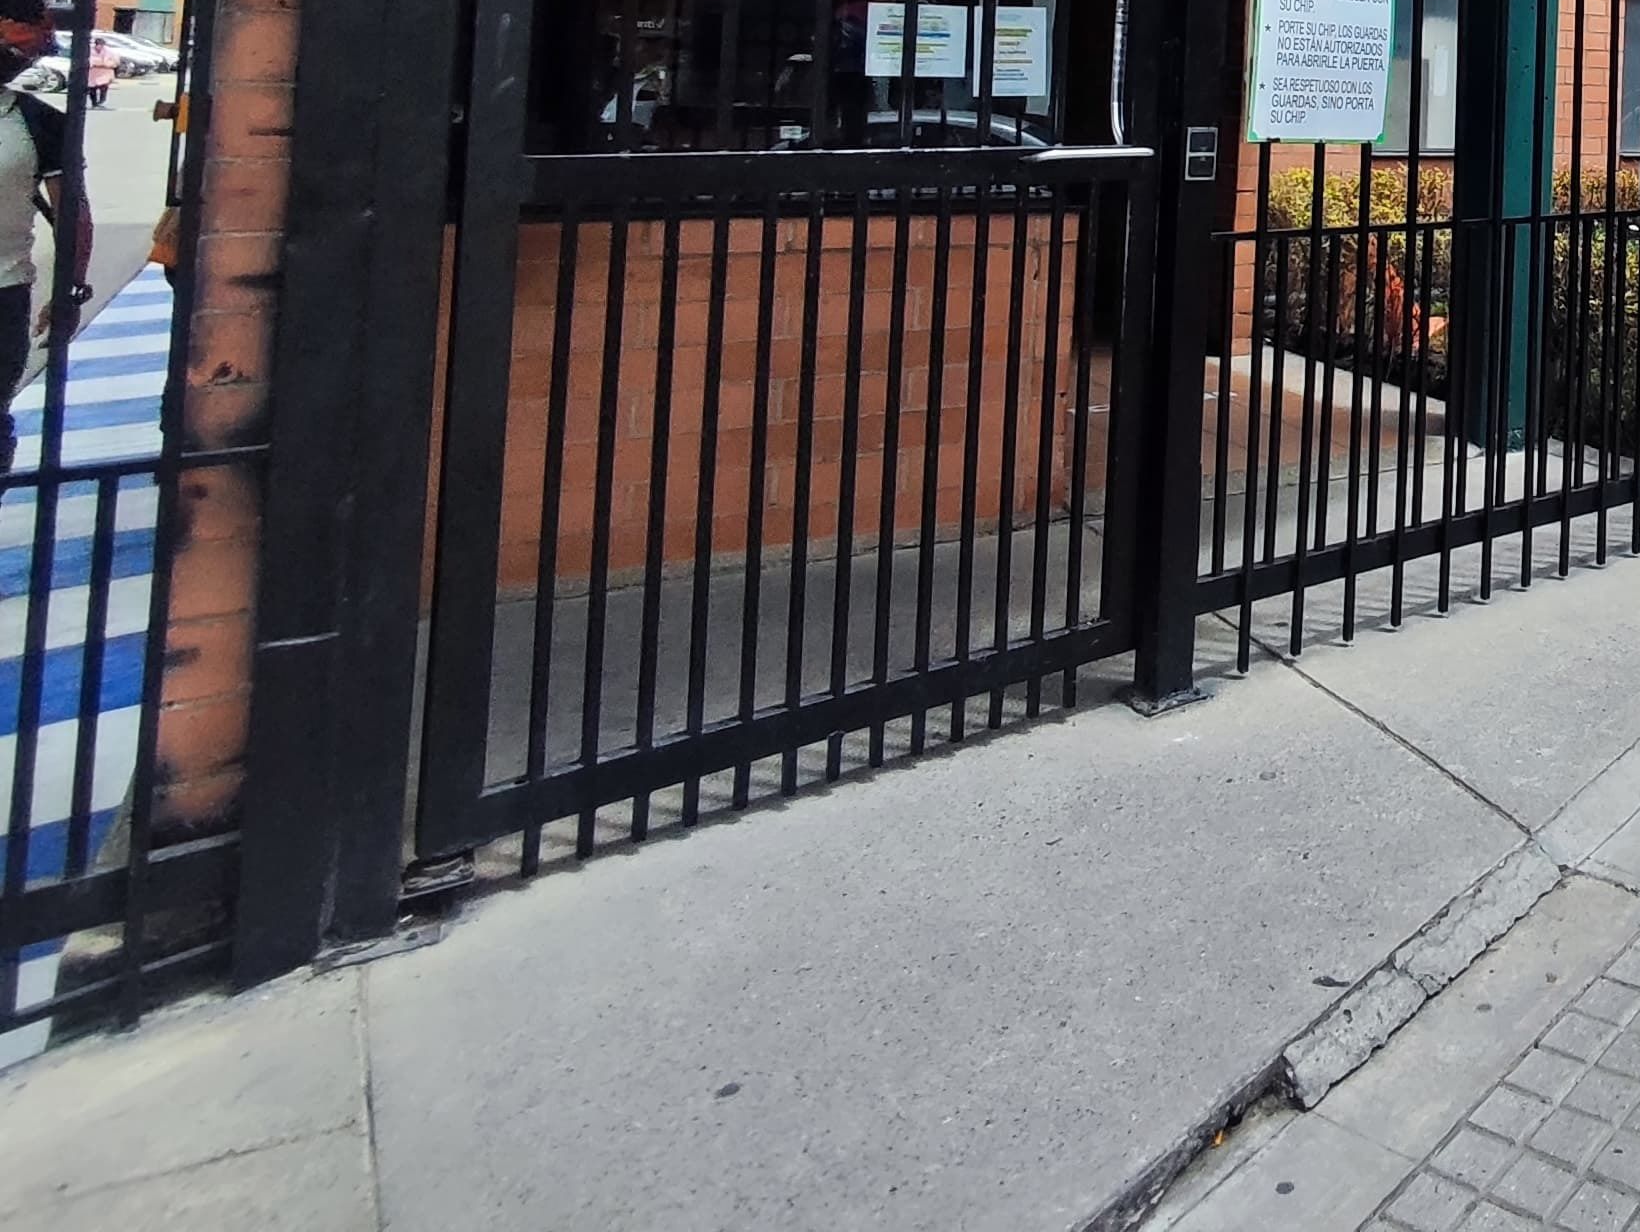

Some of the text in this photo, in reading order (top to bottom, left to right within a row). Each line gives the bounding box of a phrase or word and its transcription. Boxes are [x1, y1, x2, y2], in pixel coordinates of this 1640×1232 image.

[1278, 19, 1305, 34] PORTE
[1306, 21, 1317, 36] SU
[1338, 24, 1353, 39] LOS
[1354, 25, 1388, 41] GUARDAS
[1277, 36, 1292, 50] NO
[1323, 39, 1383, 57] AUTORIZADOS
[1276, 52, 1300, 66] PARA
[1300, 53, 1338, 69] ABRIRLE
[1339, 55, 1351, 70] LA
[1272, 77, 1374, 95] SEA RESPETUOSO CON LOS
[1271, 93, 1319, 111] GUARDAS,
[1345, 96, 1375, 111] PORTA
[1270, 109, 1284, 124] SU
